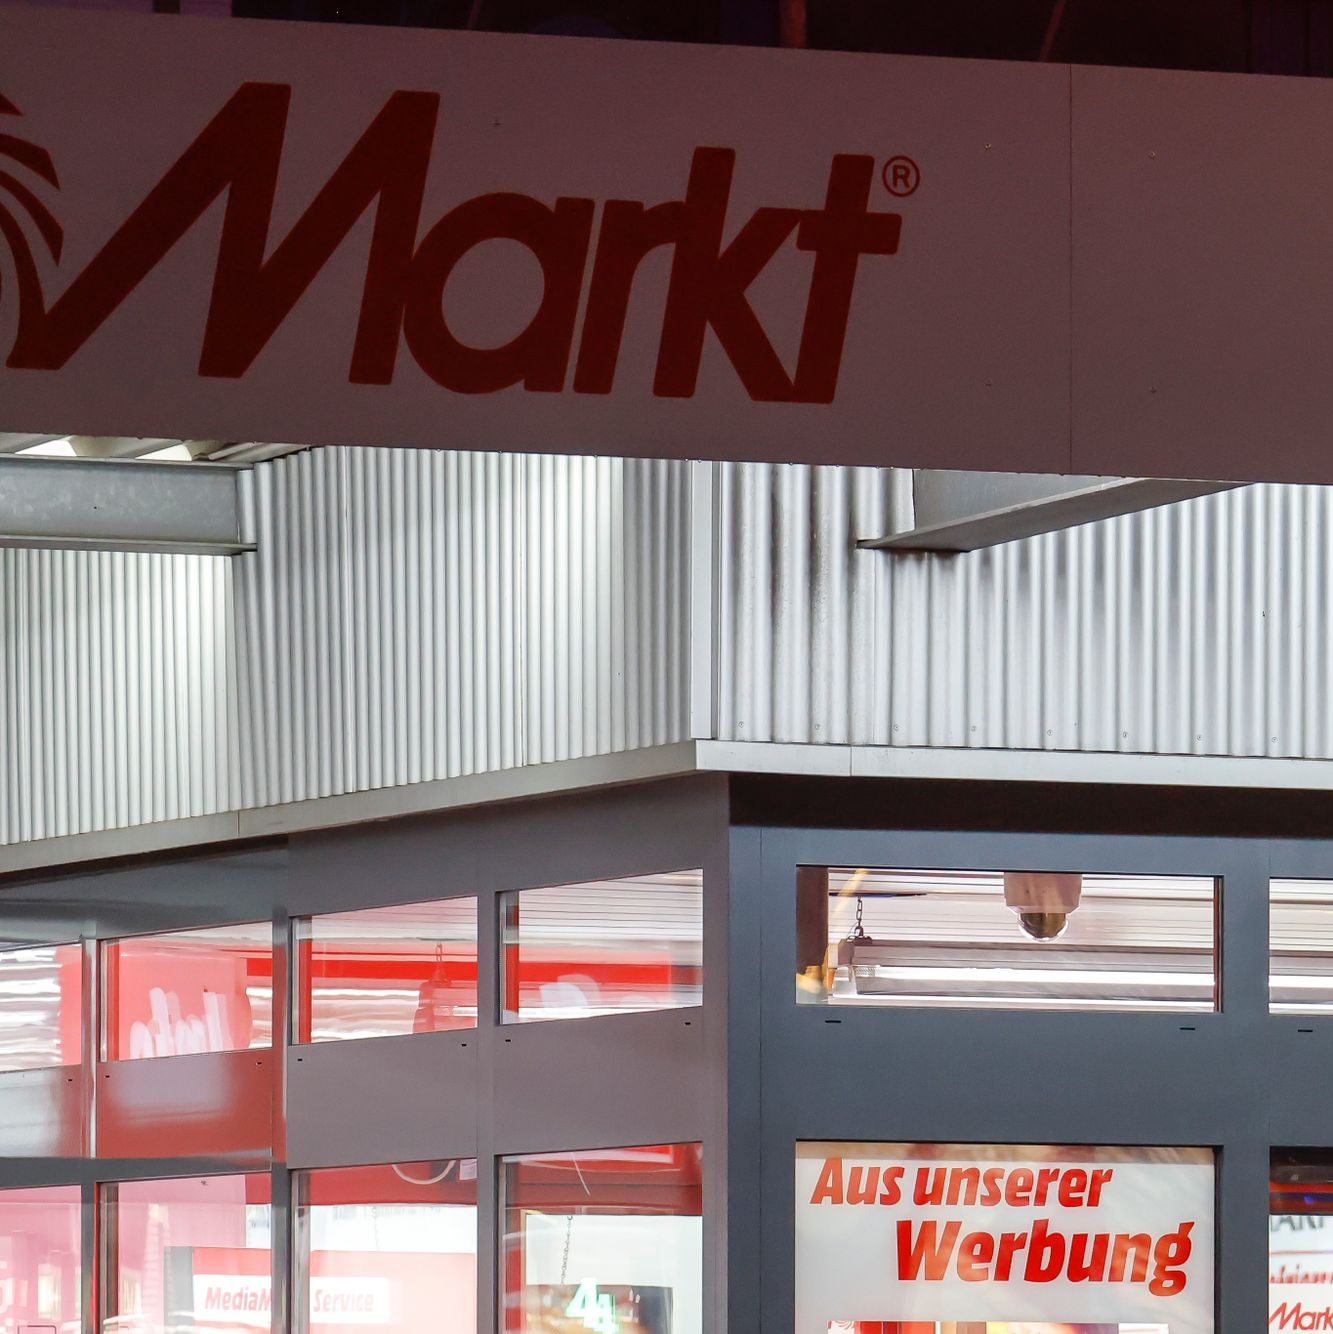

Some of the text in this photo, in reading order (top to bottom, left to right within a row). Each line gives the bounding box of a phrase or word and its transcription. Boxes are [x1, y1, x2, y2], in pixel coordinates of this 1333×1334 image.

[5, 82, 902, 404] Markt
[809, 1157, 1113, 1208] Aus unserer
[896, 1218, 1195, 1297] Werbung
[313, 1289, 374, 1312] Service
